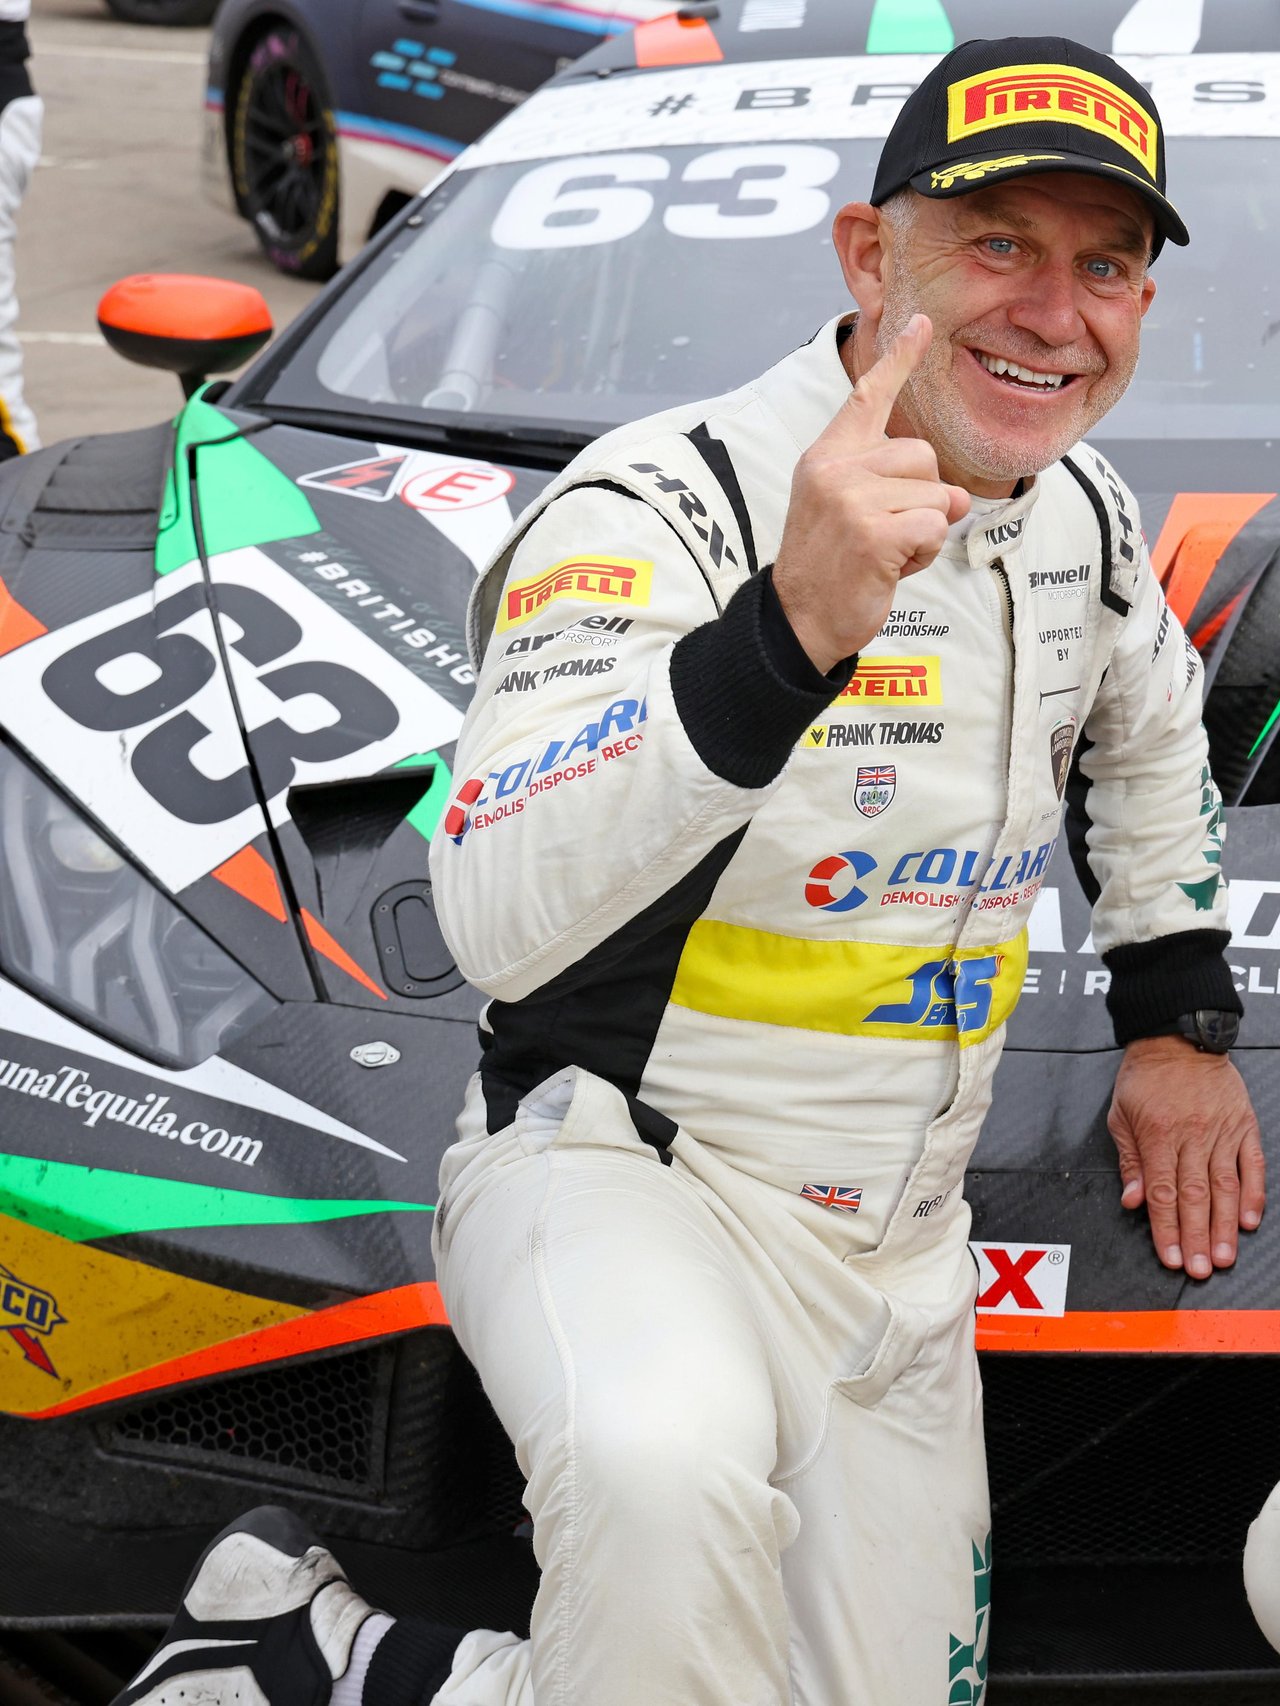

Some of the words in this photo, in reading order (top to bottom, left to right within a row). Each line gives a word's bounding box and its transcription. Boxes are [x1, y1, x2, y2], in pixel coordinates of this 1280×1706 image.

[964, 74, 1149, 157] PIRELLI
[491, 144, 840, 250] 63
[421, 470, 496, 503] E
[627, 463, 738, 570] HRX
[507, 562, 637, 621] PIRELLI
[878, 625, 949, 637] MPIONSHIP
[1057, 648, 1069, 661] BY
[494, 671, 540, 696] ANK
[543, 657, 617, 686] THOMAS
[840, 666, 928, 697] RELLI
[42, 582, 400, 825] 63
[827, 722, 877, 748] FRANK
[879, 722, 944, 745] THOMAS
[529, 759, 597, 797] DISPOSE
[602, 733, 645, 761] RECY
[863, 805, 881, 814] BRDC
[881, 890, 960, 907] DEMOLISH
[978, 892, 1019, 911] DISPOSE
